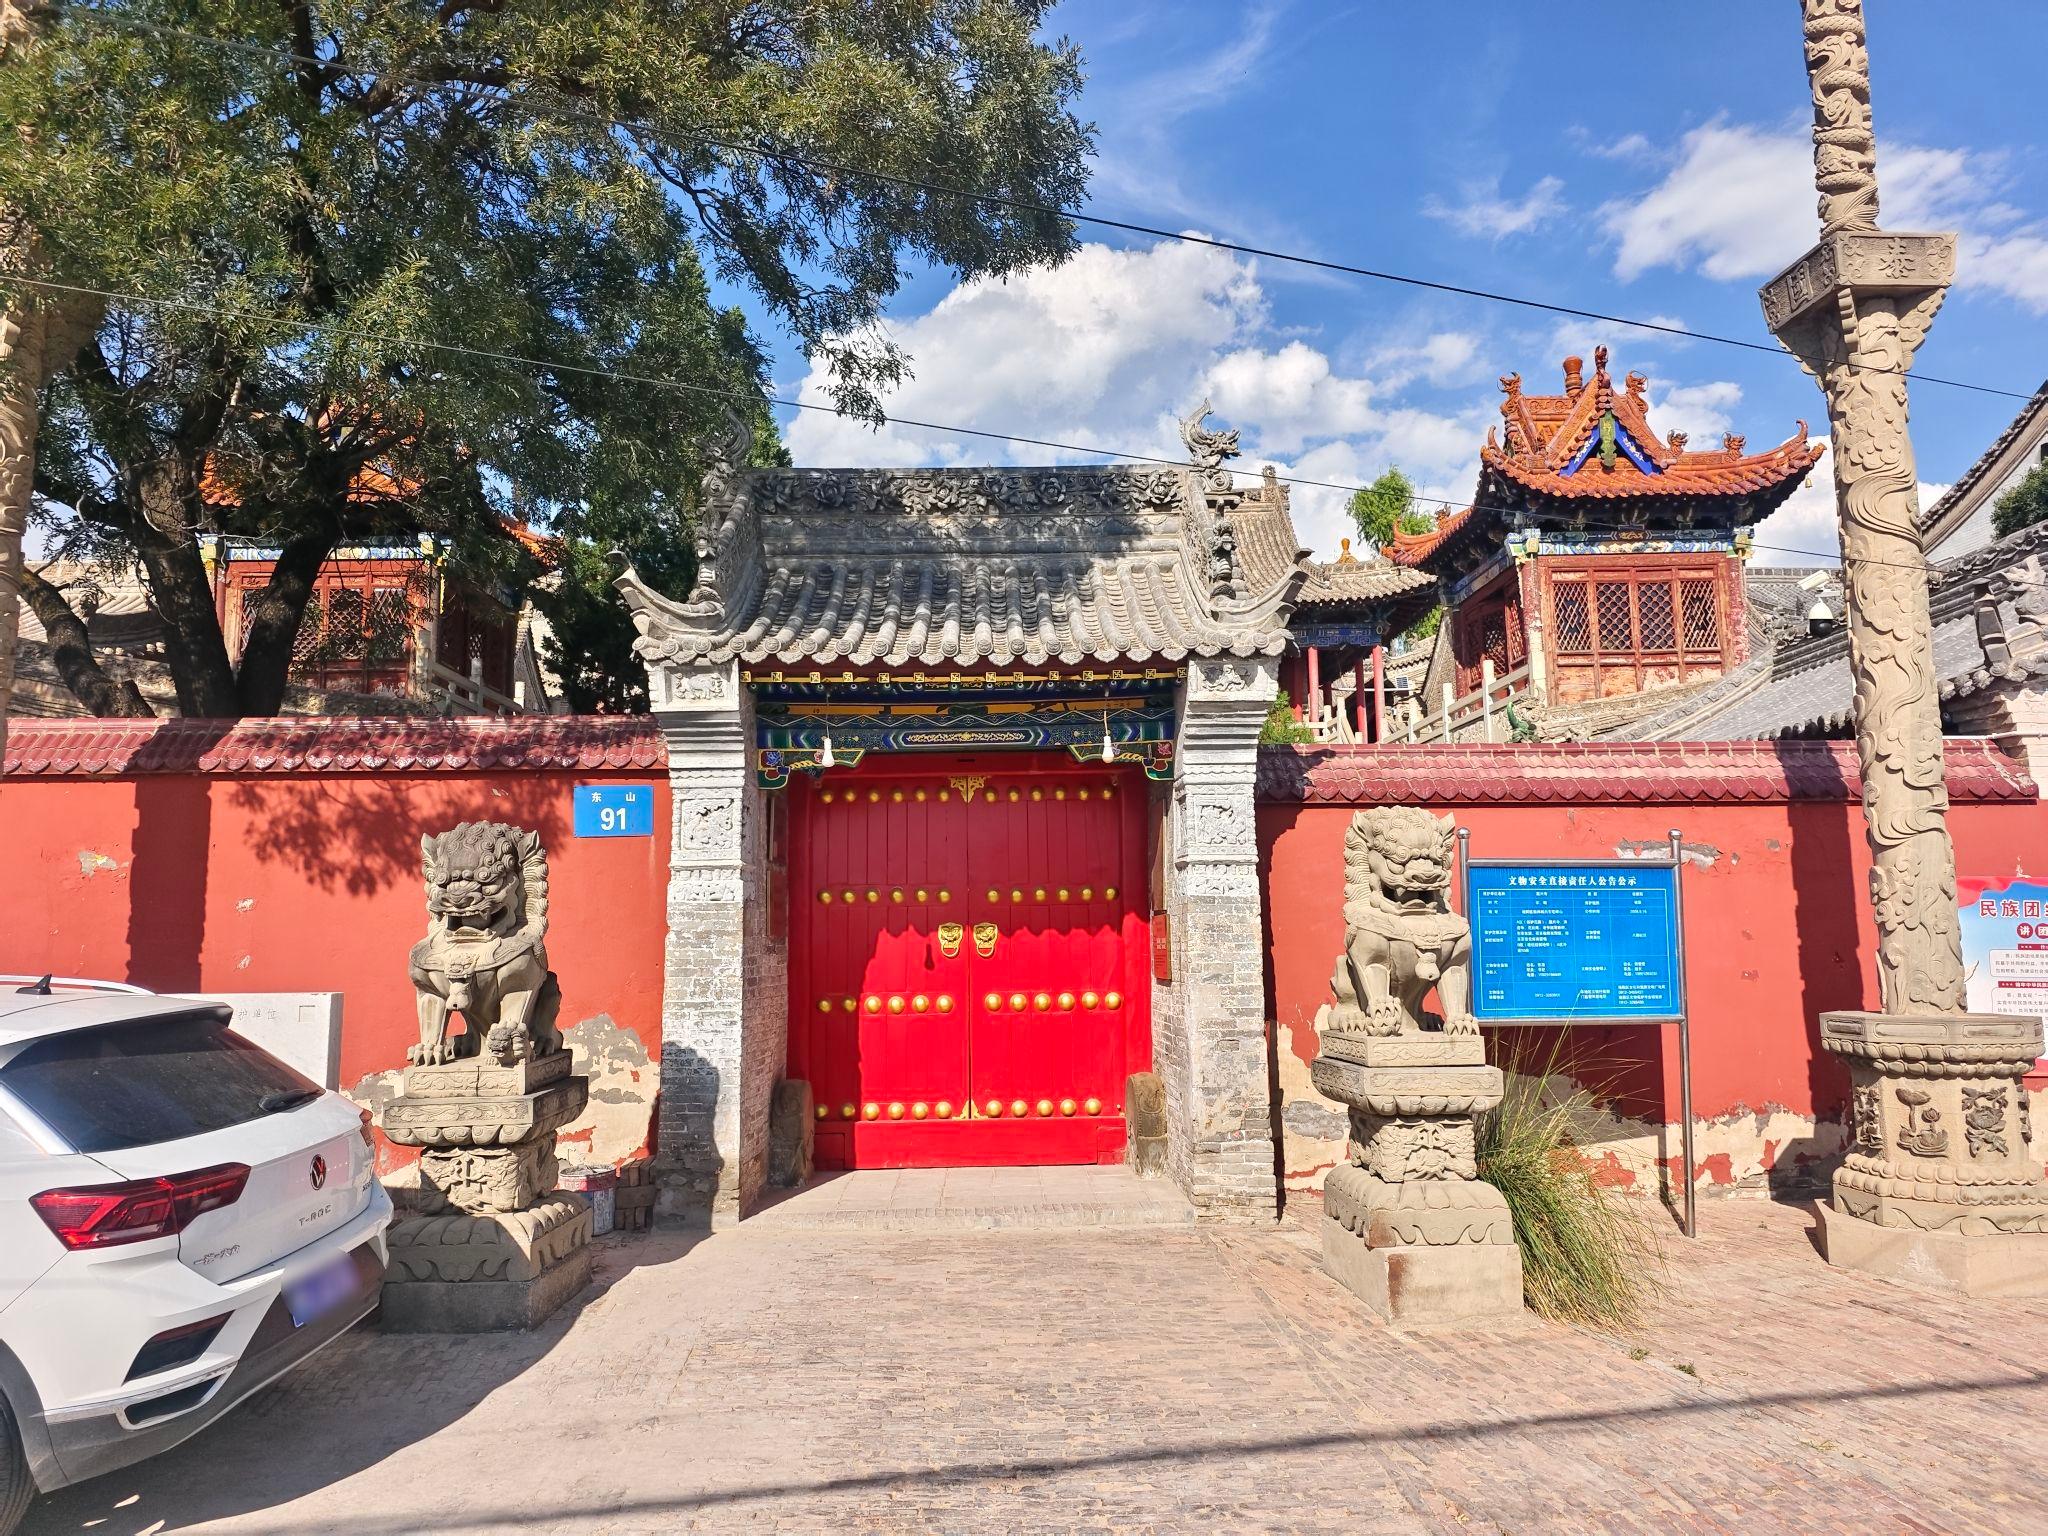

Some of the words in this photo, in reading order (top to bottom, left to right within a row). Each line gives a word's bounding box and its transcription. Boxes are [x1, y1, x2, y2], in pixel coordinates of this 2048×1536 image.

[591, 791, 636, 803] 东山
[600, 807, 627, 831] 91
[1508, 875, 1638, 887] 文物安全直接责任人公告公示
[1980, 900, 2048, 918] 民族团
[298, 1204, 332, 1227] T-ROC
